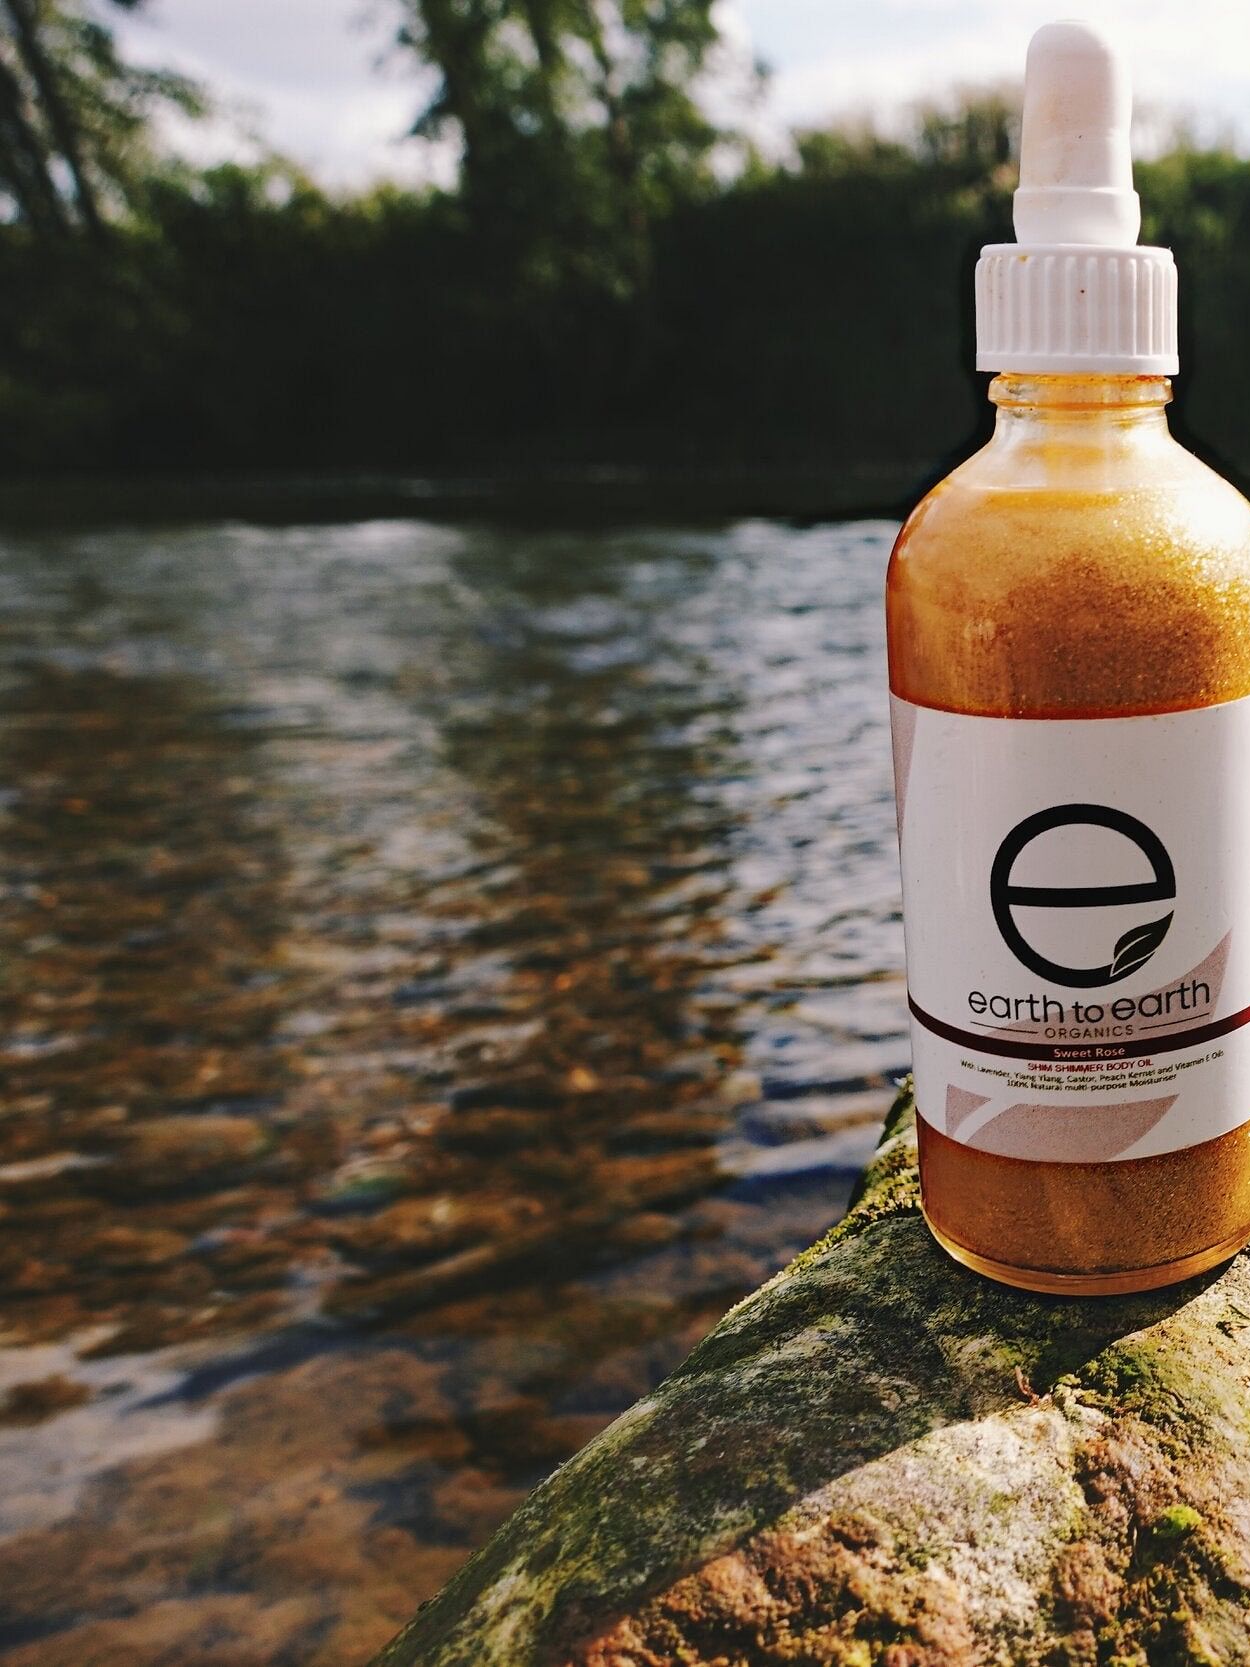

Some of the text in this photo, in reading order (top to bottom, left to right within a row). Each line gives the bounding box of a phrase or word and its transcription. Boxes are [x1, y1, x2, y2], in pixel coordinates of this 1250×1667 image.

[968, 979, 1210, 1024] earth to earth
[1044, 1024, 1134, 1040] ORGANICS
[1053, 1047, 1125, 1059] Sweet Rose
[1027, 1059, 1153, 1073] SHIM SHIMMER BODY OIL
[1099, 1072, 1126, 1082] Peach
[1158, 1065, 1173, 1074] and
[1175, 1057, 1204, 1071] Vitamin
[1030, 1082, 1062, 1091] Natural
